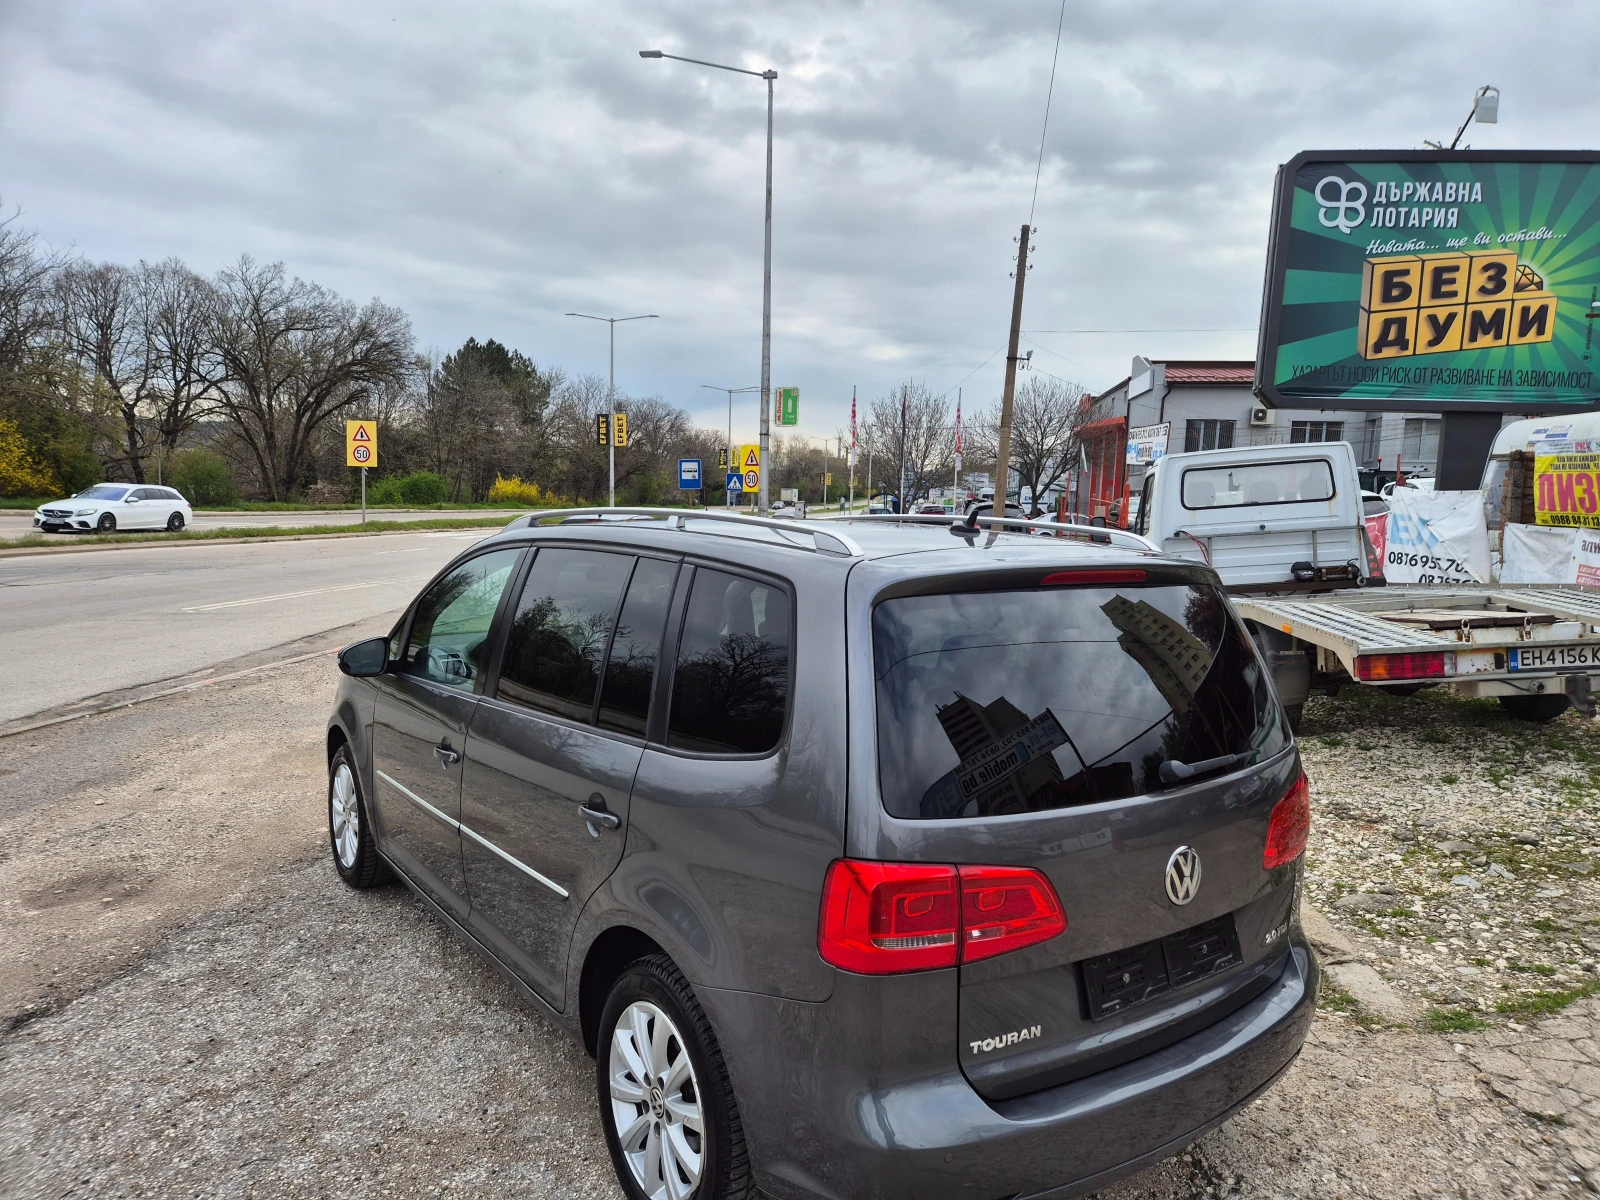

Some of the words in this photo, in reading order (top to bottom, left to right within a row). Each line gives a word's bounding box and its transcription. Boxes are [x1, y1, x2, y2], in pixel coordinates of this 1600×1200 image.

[1373, 181, 1482, 204] ДЪРЖАВНА
[1370, 207, 1459, 228] ЛОТАРИЯ
[1366, 238, 1439, 254] Новата...
[1446, 236, 1468, 249] ще
[1473, 233, 1491, 245] ви
[1498, 226, 1567, 243] остави...
[1382, 262, 1508, 304] БЕЗ
[1373, 304, 1549, 354] ДУМИ
[1292, 365, 1347, 381] ХАЗАРТЪТ
[1348, 366, 1380, 382] НОСИ
[1381, 366, 1411, 383] РИСК
[1413, 367, 1429, 384] ОТ
[1430, 368, 1496, 386] РАЗВИВАНЕ
[1498, 369, 1513, 386] НА
[1515, 370, 1593, 389] ЗАВИСИМОСТ
[356, 449, 368, 459] 50
[747, 474, 756, 484] 50
[1445, 558, 1470, 573] 70
[1521, 649, 1543, 667] EH
[1546, 647, 1588, 665] 4156
[969, 1024, 1042, 1055] TOURAN
